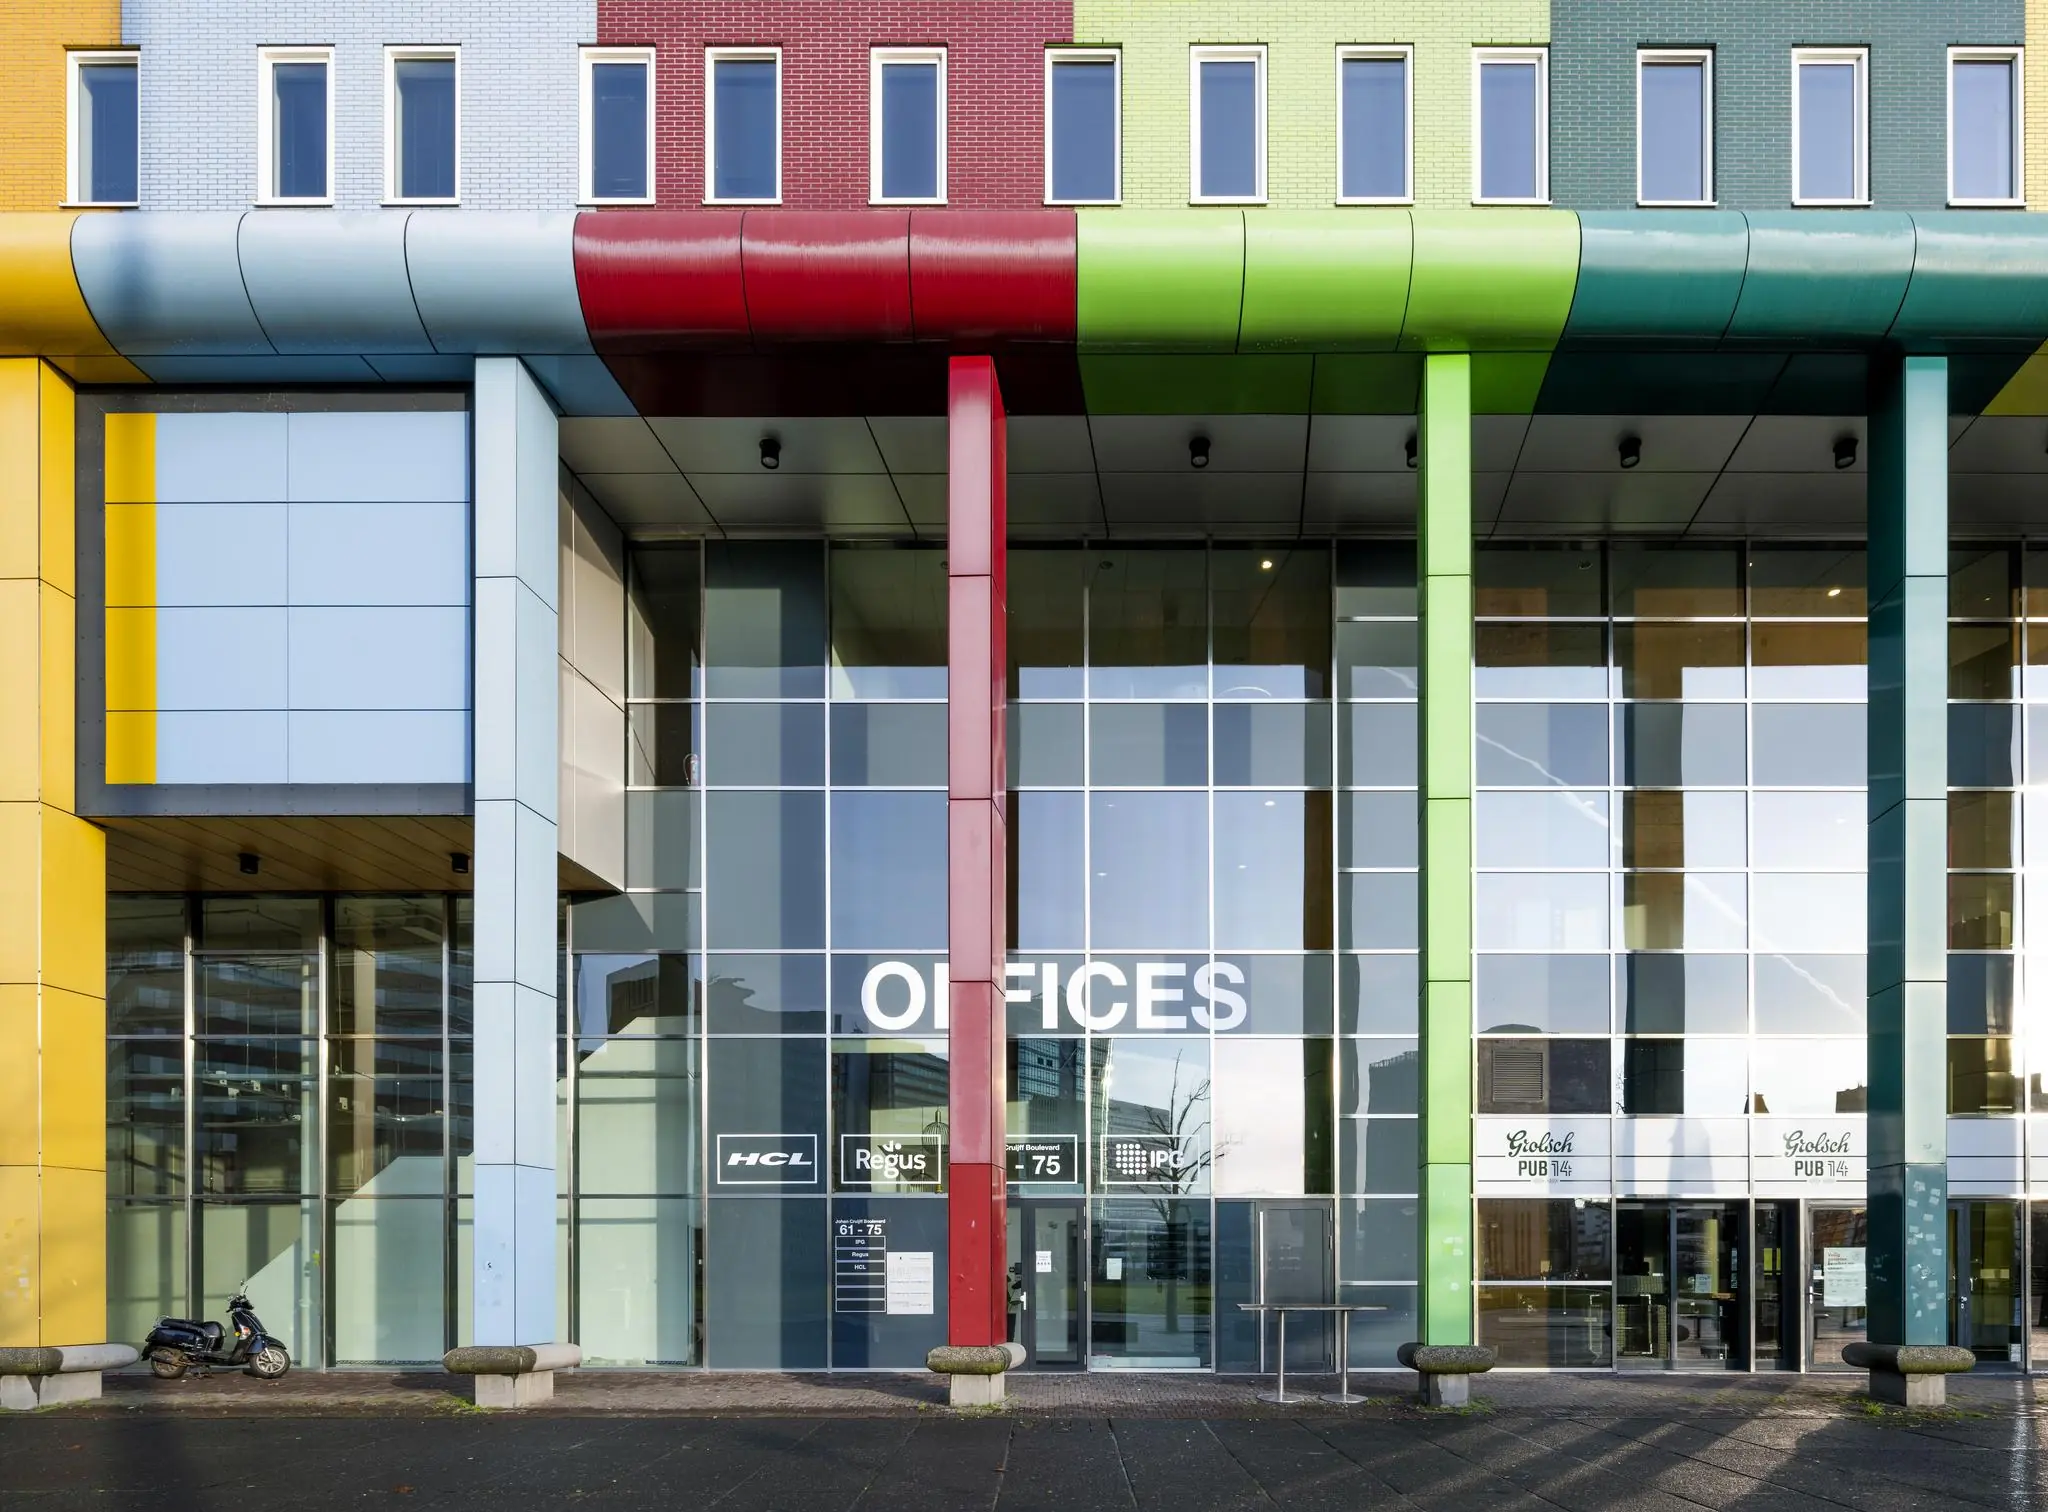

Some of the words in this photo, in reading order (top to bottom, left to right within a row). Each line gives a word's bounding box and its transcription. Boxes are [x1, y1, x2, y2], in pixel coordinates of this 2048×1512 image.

[1506, 1130, 1575, 1158] Grolsch
[1783, 1130, 1851, 1158] Grolsch
[727, 1152, 813, 1166] HCL
[856, 1147, 926, 1179] Regus
[1032, 1155, 1061, 1175] 75
[1150, 1150, 1185, 1169] IPG
[1518, 1160, 1548, 1177] PUB
[1551, 1160, 1573, 1177] 14
[1794, 1160, 1824, 1177] PUB
[1827, 1160, 1849, 1177] 14
[839, 1224, 854, 1235] 61
[866, 1224, 882, 1235] 75
